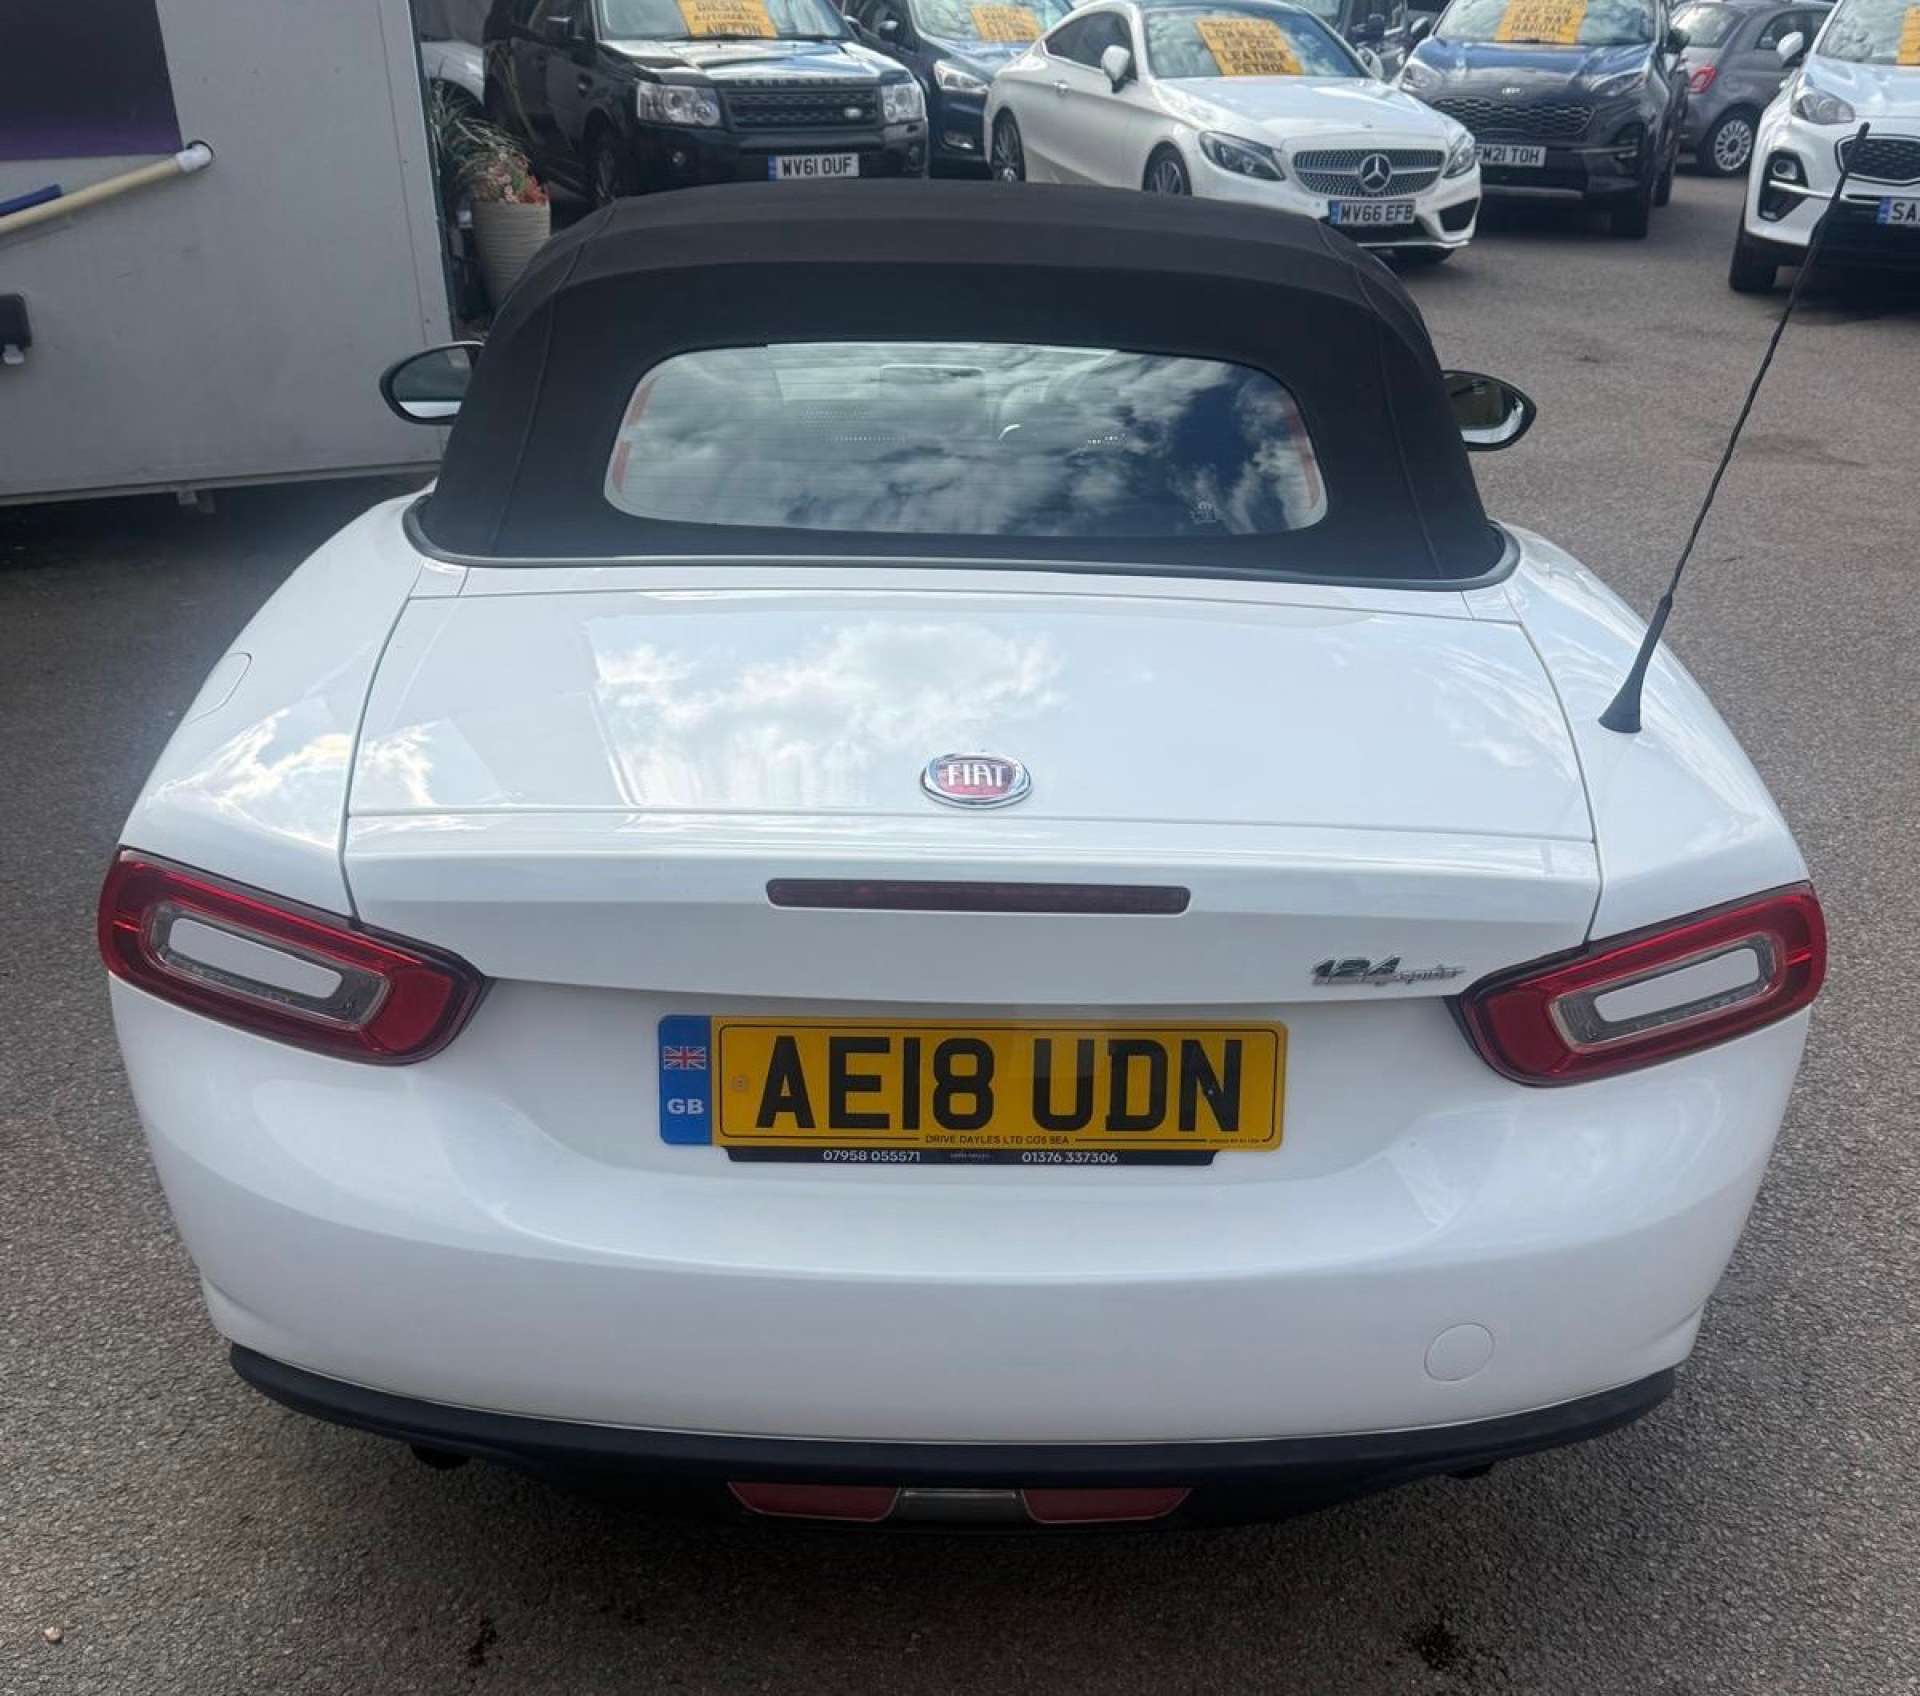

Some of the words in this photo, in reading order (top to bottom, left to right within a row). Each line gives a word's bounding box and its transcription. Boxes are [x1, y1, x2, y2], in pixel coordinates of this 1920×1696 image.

[822, 156, 853, 174] OUF
[1891, 201, 1920, 222] SA
[947, 763, 1009, 787] FIAT
[1312, 956, 1401, 985] 124
[755, 1035, 994, 1131] AE18
[1031, 1037, 1243, 1132] UDN
[666, 1098, 705, 1115] GB
[925, 1135, 955, 1145] DRIVE
[959, 1135, 1000, 1145] DAYLES
[1002, 1135, 1023, 1145] LTD
[823, 1150, 868, 1161] 07958
[871, 1151, 921, 1162] 055571
[1021, 1151, 1062, 1163] 01376
[1065, 1152, 1118, 1163] 337306
